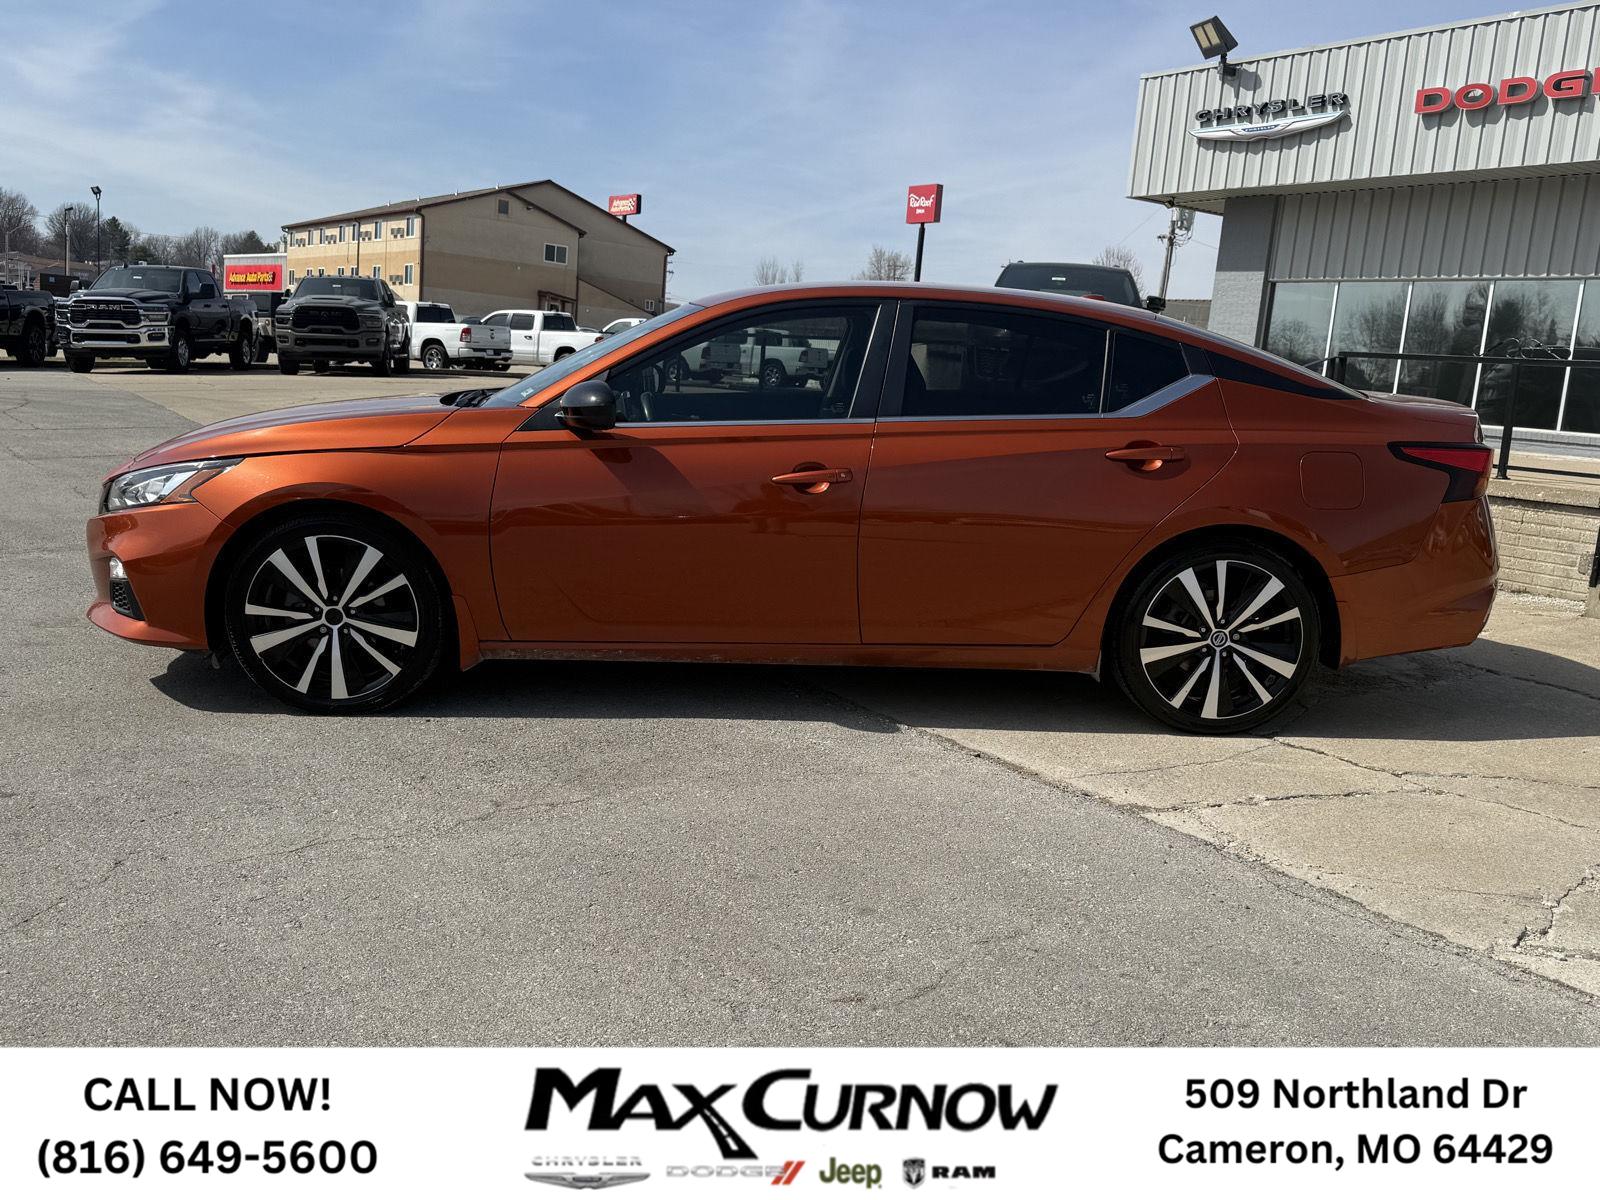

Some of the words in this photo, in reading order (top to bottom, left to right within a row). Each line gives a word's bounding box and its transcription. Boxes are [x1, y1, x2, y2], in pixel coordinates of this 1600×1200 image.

[1414, 67, 1600, 114] DODG
[1195, 92, 1345, 123] CHRYSLER
[86, 303, 121, 311] RAM
